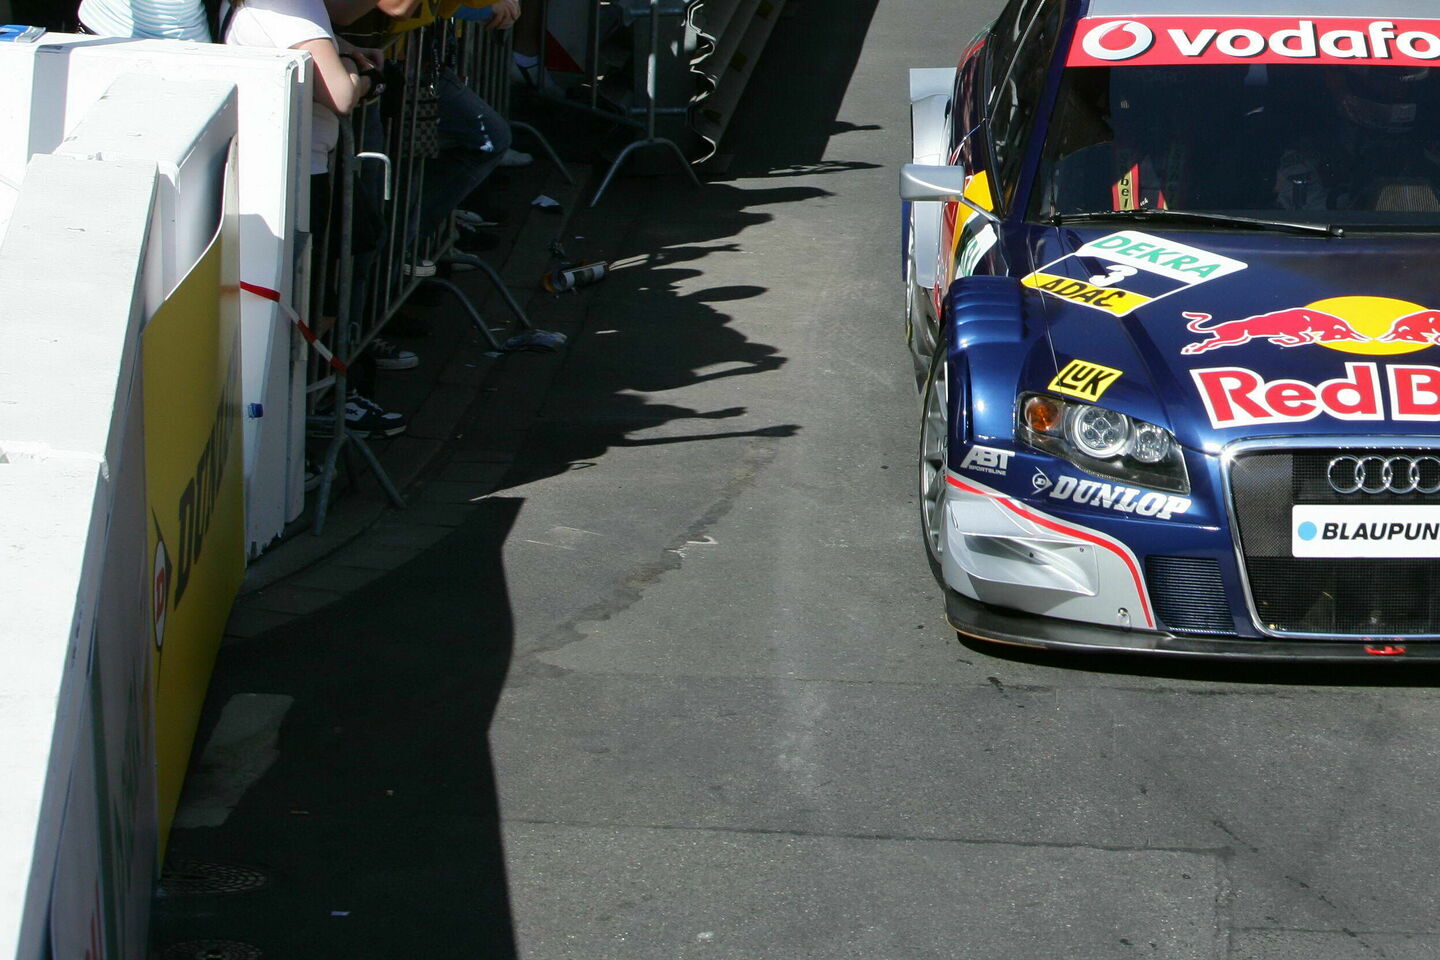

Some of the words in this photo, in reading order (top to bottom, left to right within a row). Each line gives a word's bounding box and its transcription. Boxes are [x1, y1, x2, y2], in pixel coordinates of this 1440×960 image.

[1088, 264, 1139, 287] 3
[1090, 235, 1222, 279] DEKRA
[1037, 278, 1127, 308] ADAC
[1195, 364, 1380, 423] Red
[960, 444, 1016, 470] ABT
[1049, 474, 1192, 520] DUNLOP
